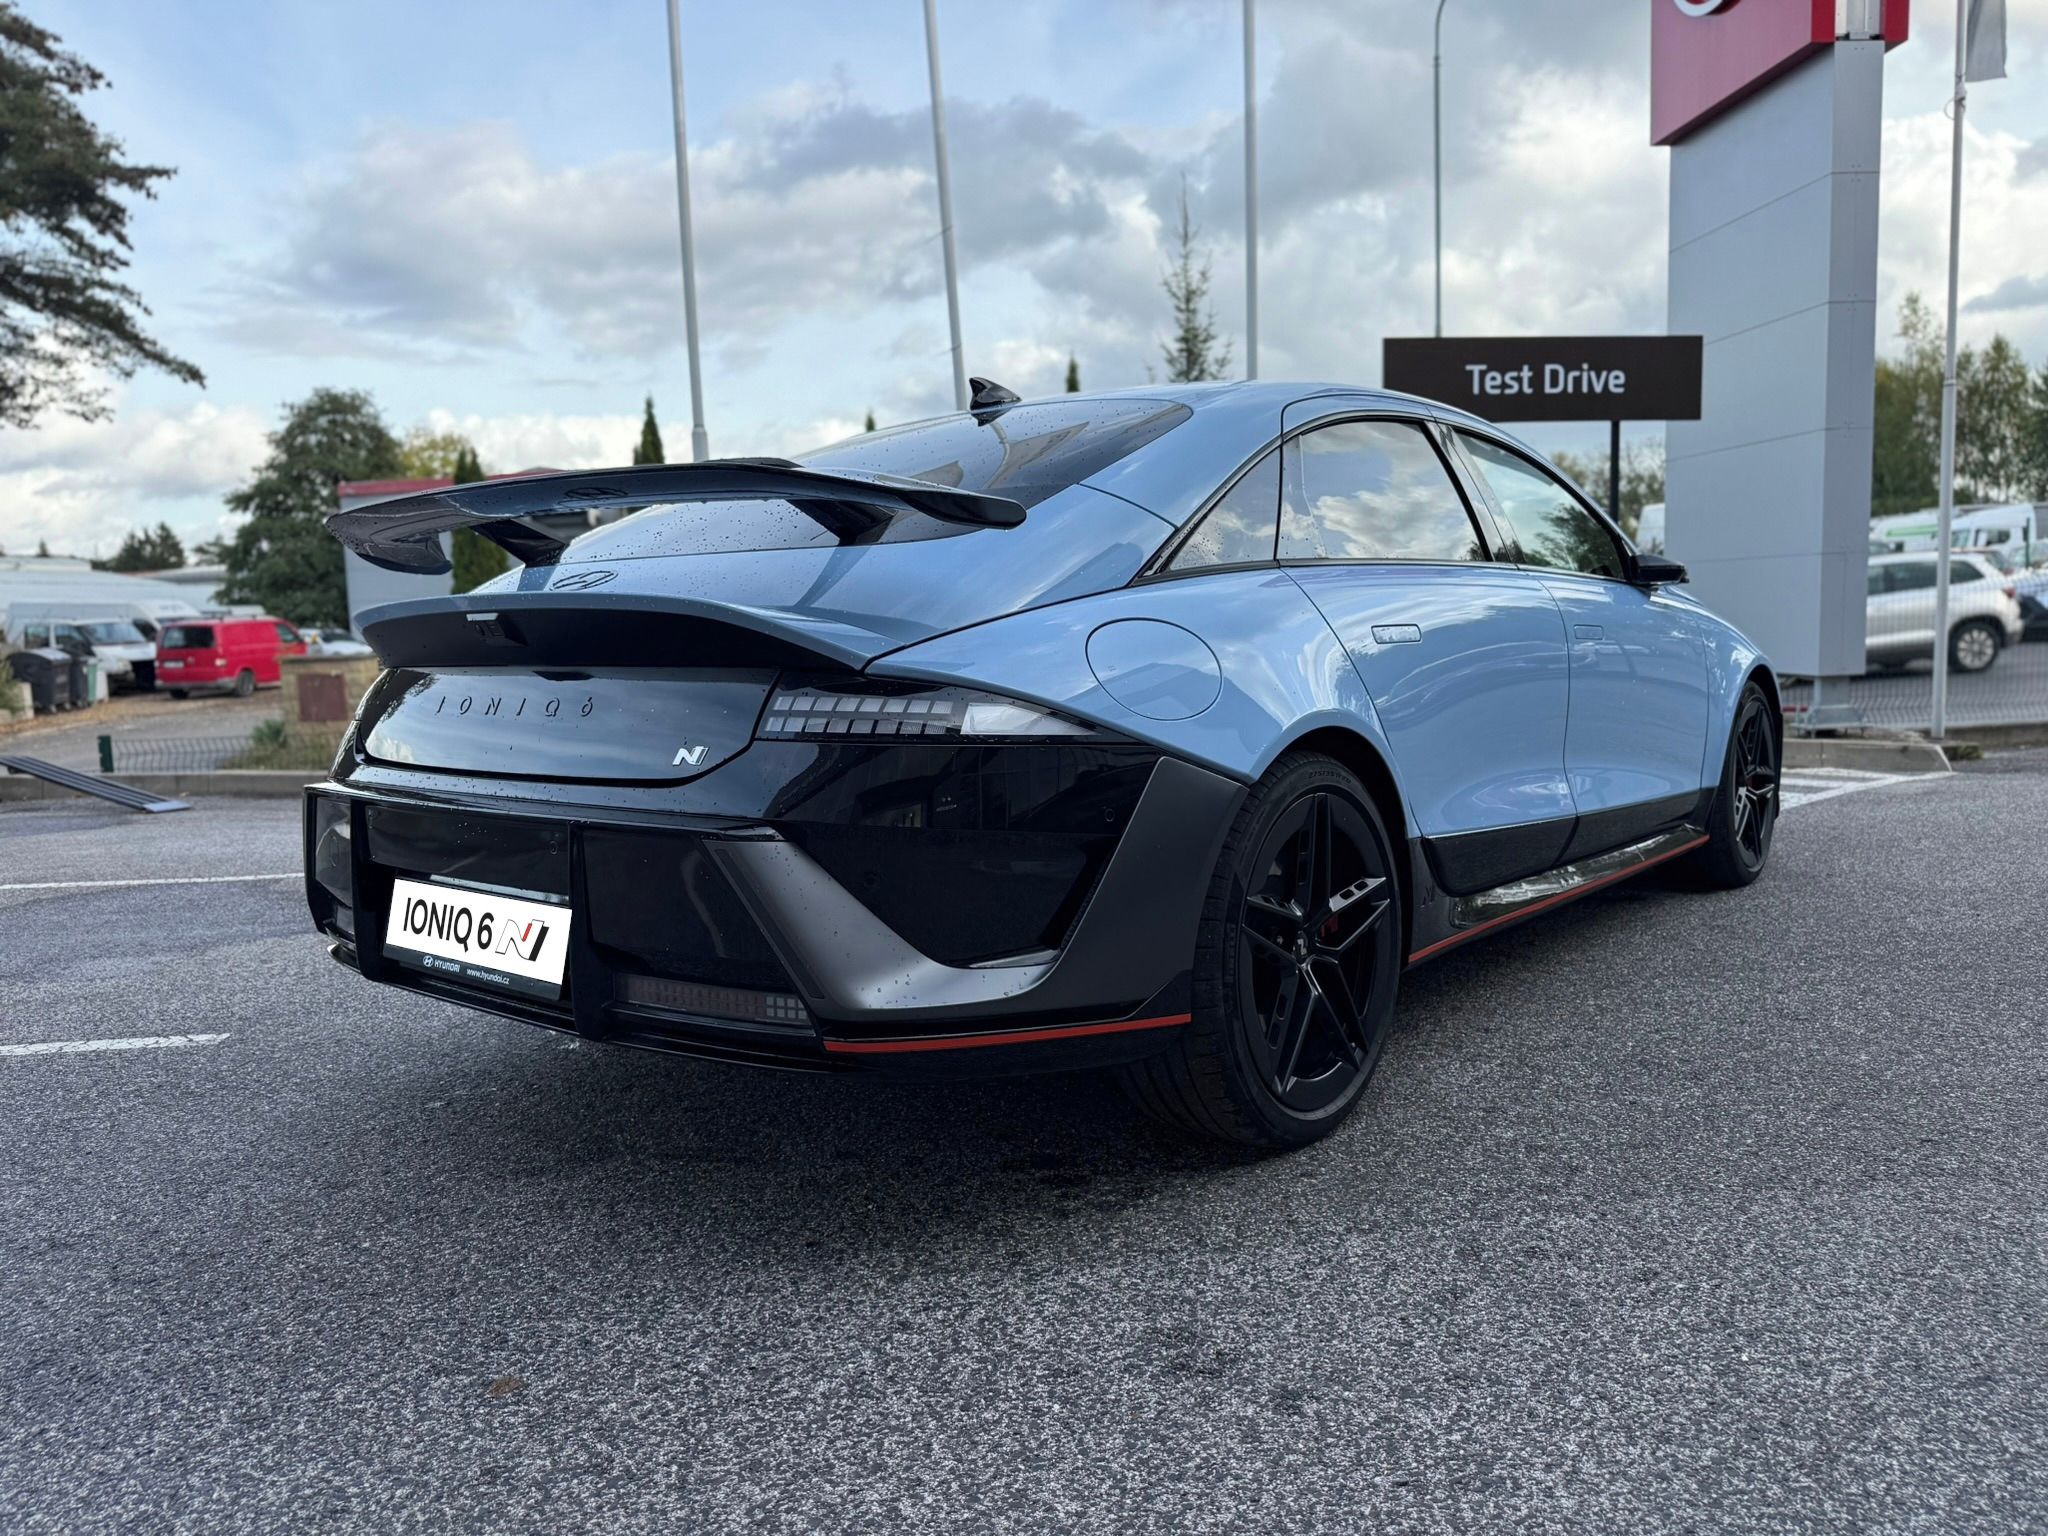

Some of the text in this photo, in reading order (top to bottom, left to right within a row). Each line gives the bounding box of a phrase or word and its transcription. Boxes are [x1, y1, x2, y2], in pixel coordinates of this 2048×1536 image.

[1465, 363, 1626, 395] Test Drive
[403, 897, 550, 962] IONIQ 6 N
[434, 959, 510, 985] HYUNDAI www.hyundai.cz
